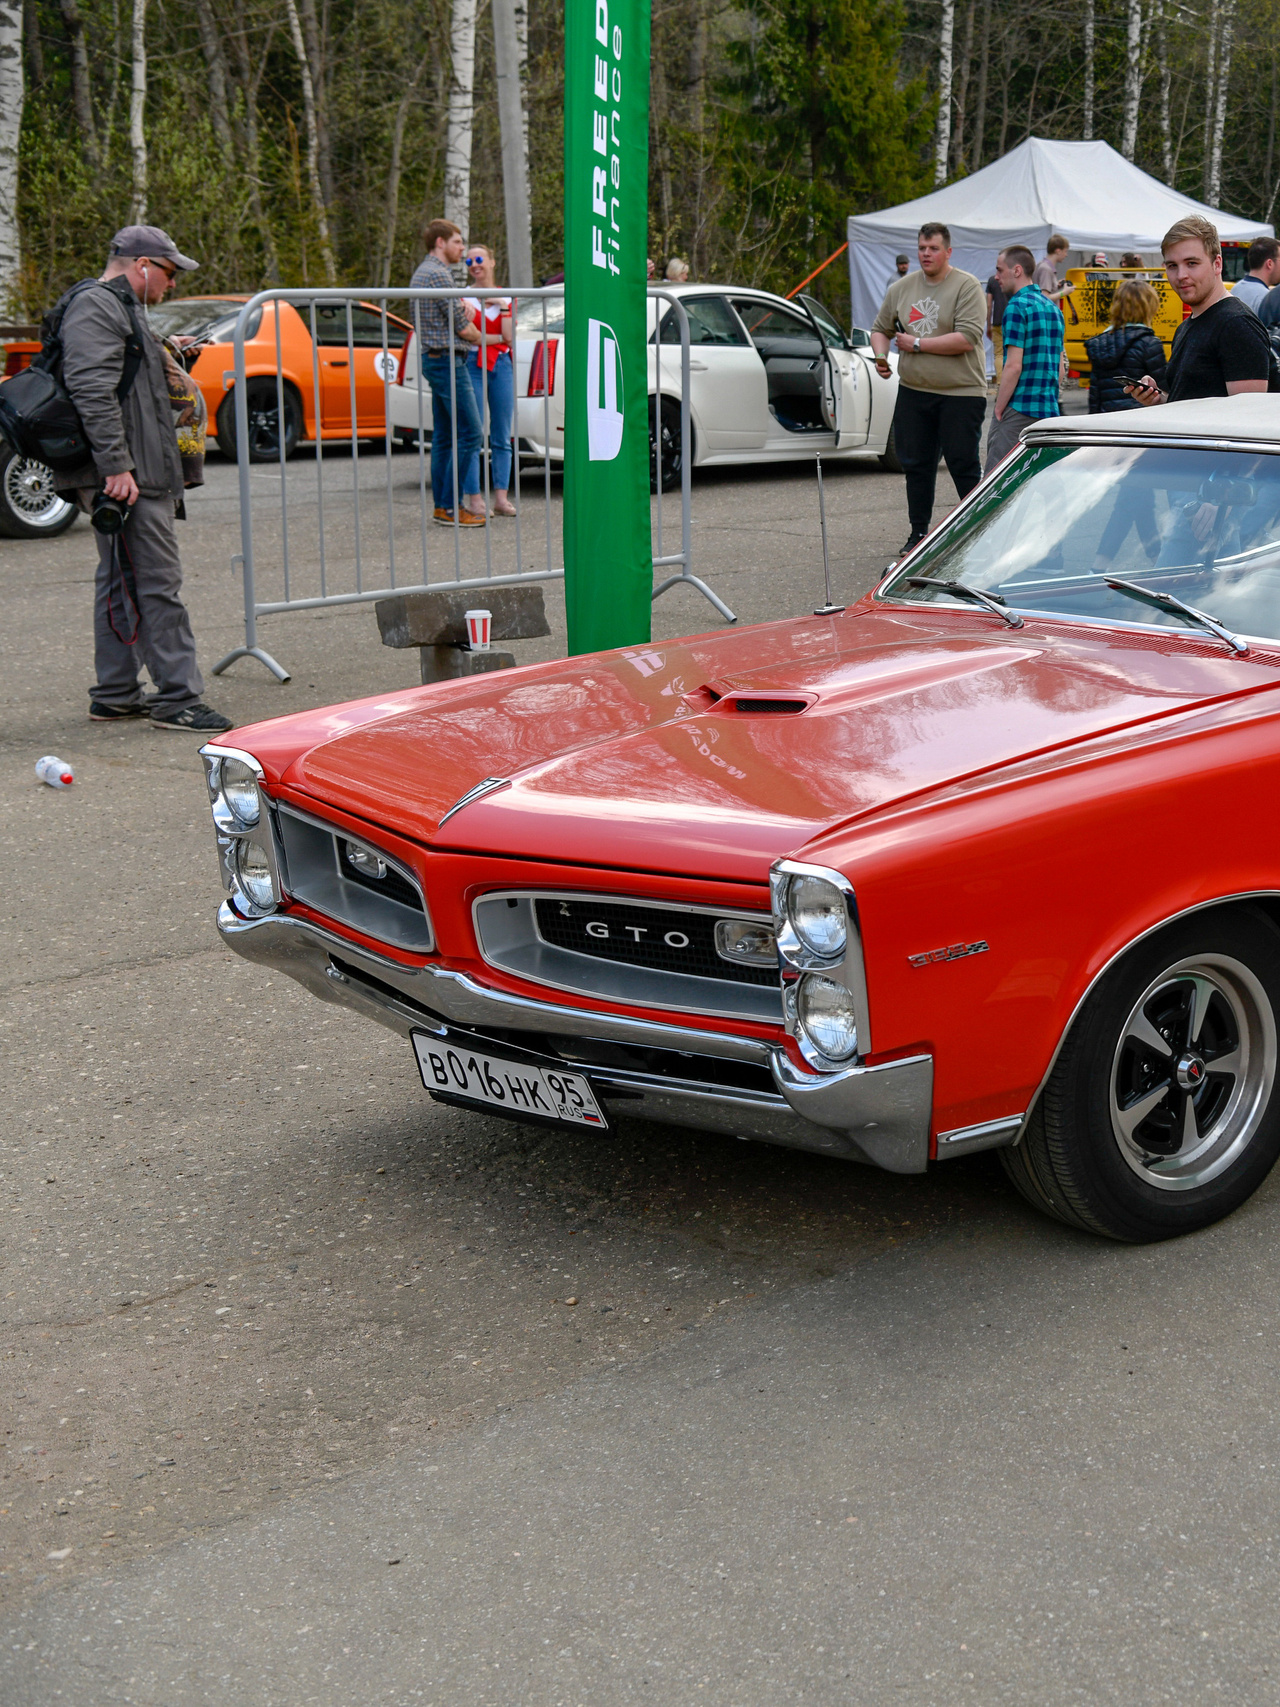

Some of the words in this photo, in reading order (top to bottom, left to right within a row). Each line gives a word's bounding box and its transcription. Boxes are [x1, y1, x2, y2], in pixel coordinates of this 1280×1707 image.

[607, 24, 622, 276] finance
[585, 921, 690, 948] GTO
[547, 1073, 585, 1107] 95
[557, 1104, 583, 1119] RUS
